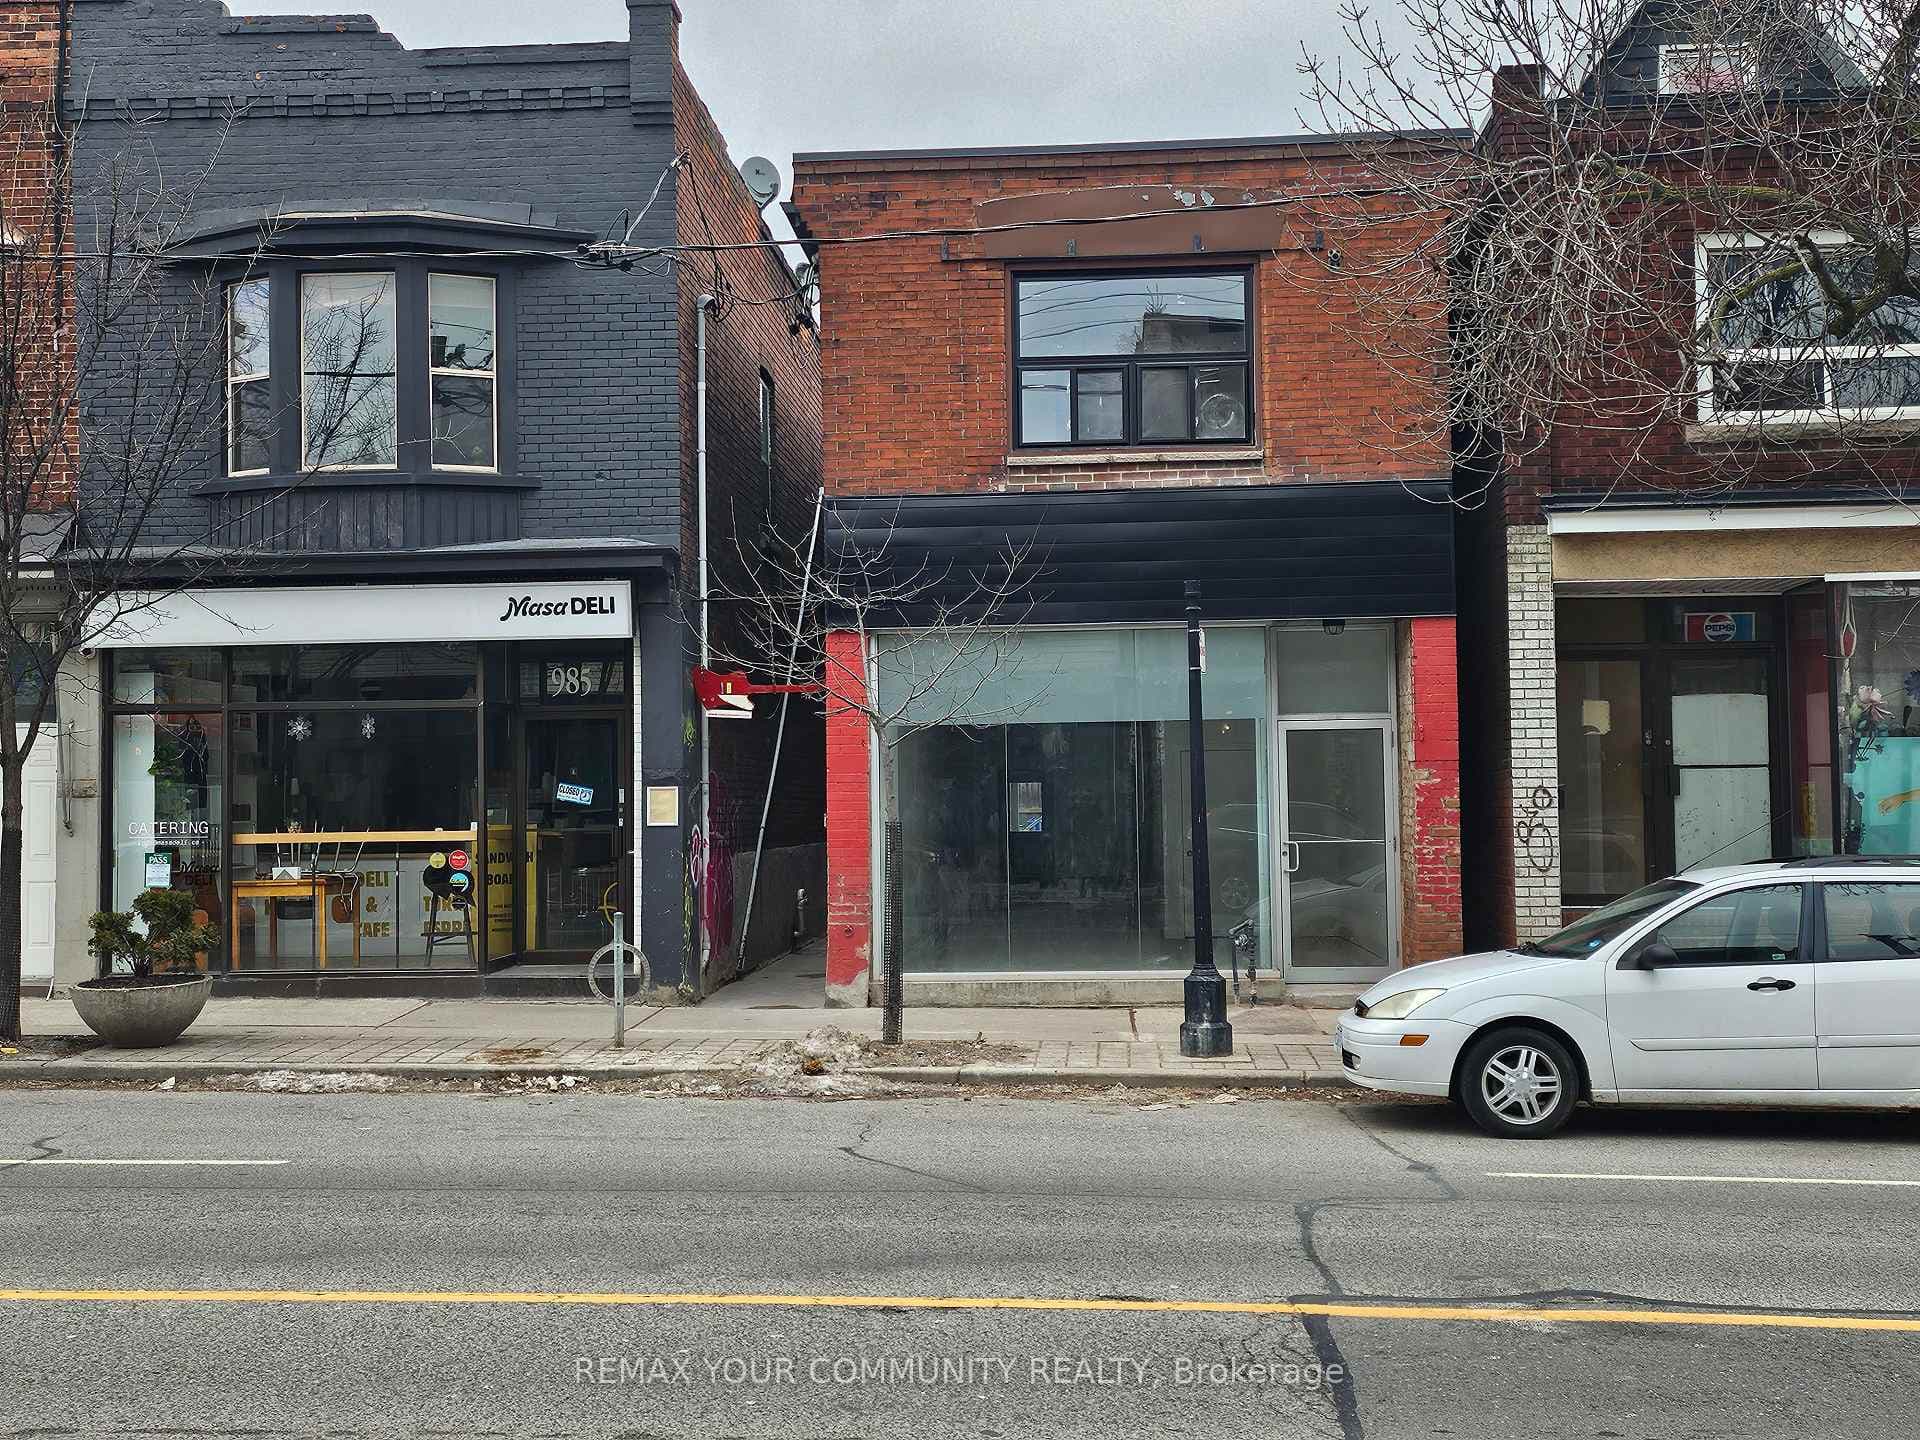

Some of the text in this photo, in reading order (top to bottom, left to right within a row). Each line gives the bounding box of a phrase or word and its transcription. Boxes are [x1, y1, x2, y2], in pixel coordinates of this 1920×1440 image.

[500, 595, 615, 621] Masa DELI
[1704, 624, 1735, 632] PEPSI
[551, 667, 592, 697] 985
[128, 821, 209, 834] CATERING
[149, 856, 168, 864] PASS
[366, 896, 378, 913] &
[359, 921, 390, 938] AFE
